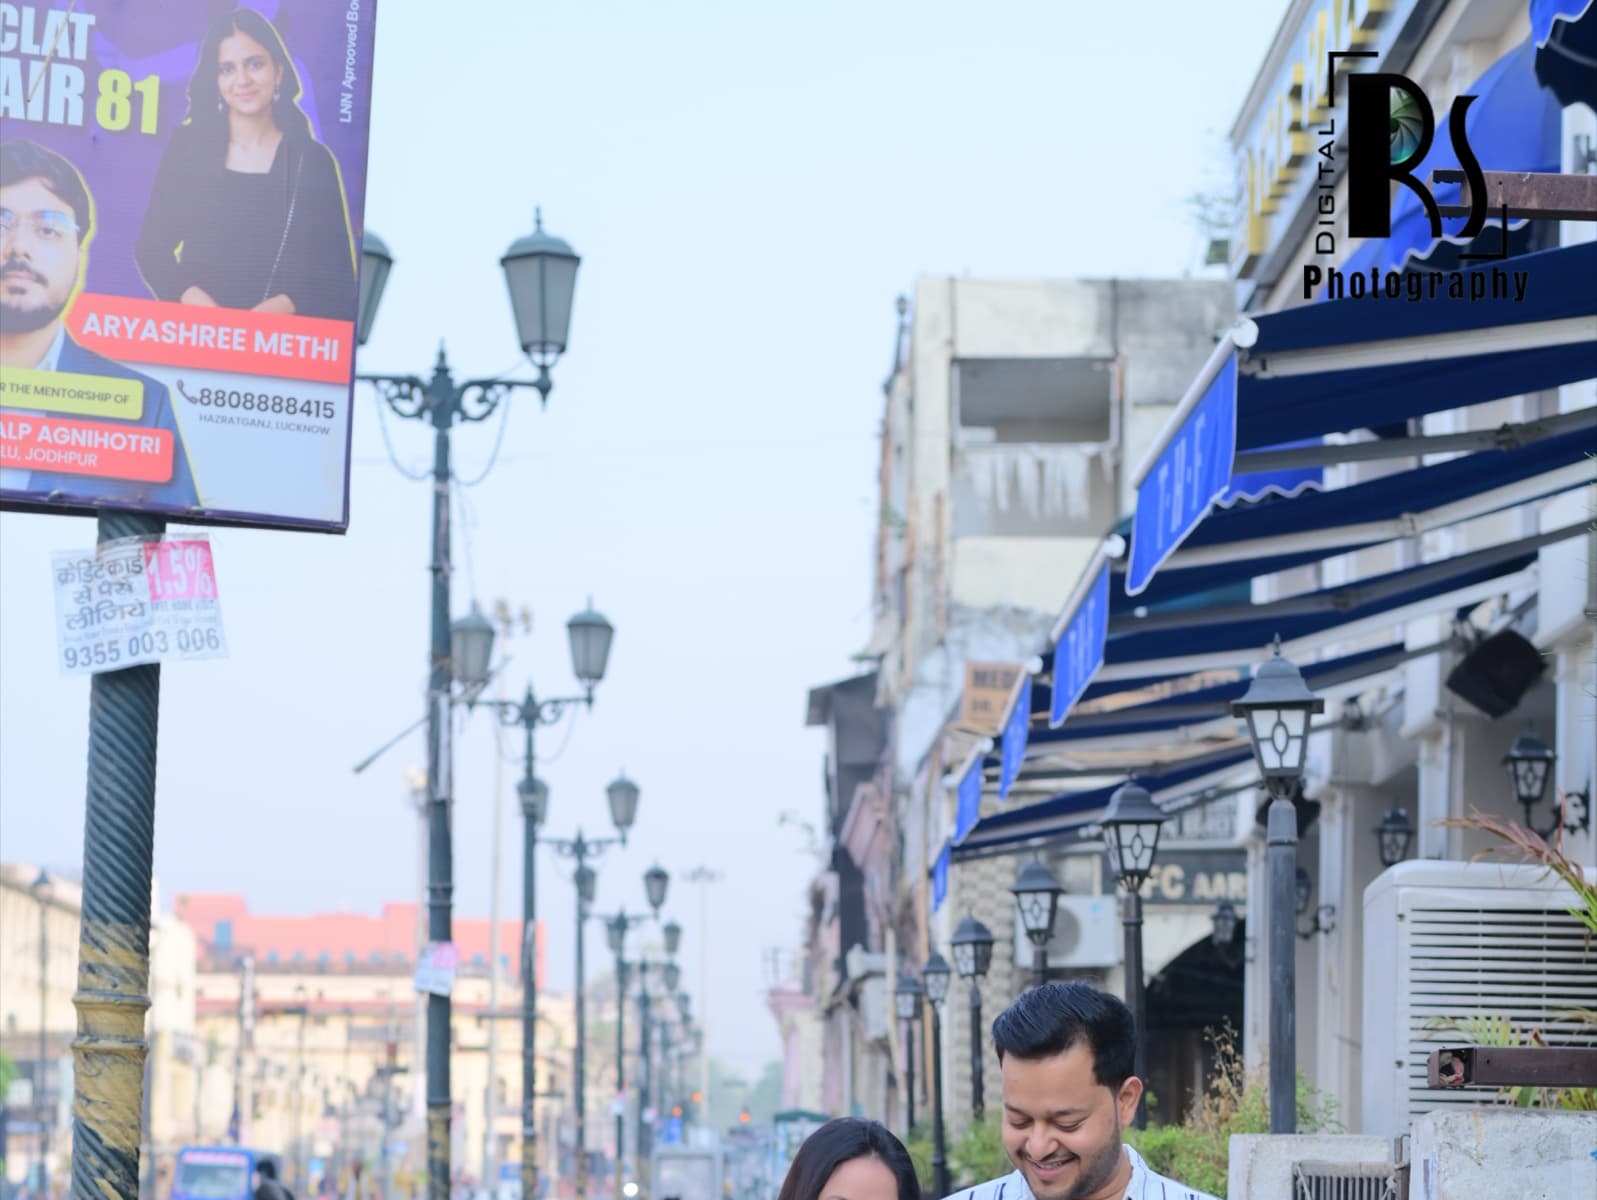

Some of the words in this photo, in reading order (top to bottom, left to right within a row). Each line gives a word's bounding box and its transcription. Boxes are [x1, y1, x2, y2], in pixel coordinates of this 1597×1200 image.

[0, 2, 96, 60] CLAT
[342, 23, 358, 90] Aprooved
[96, 68, 160, 135] 81
[340, 92, 353, 123] LNN
[82, 312, 247, 351] ARYASHREE
[255, 330, 339, 362] METHI
[10, 382, 31, 394] THE
[33, 385, 112, 403] MENTORSHIP
[113, 394, 130, 405] OF
[200, 387, 335, 419] 8808888415
[25, 448, 98, 467] JODHPUR
[37, 424, 161, 455] AGNIHOTRI
[147, 545, 213, 597] 1.5%
[64, 639, 121, 669] 9355
[128, 630, 169, 657] 003
[177, 627, 220, 651] 006
